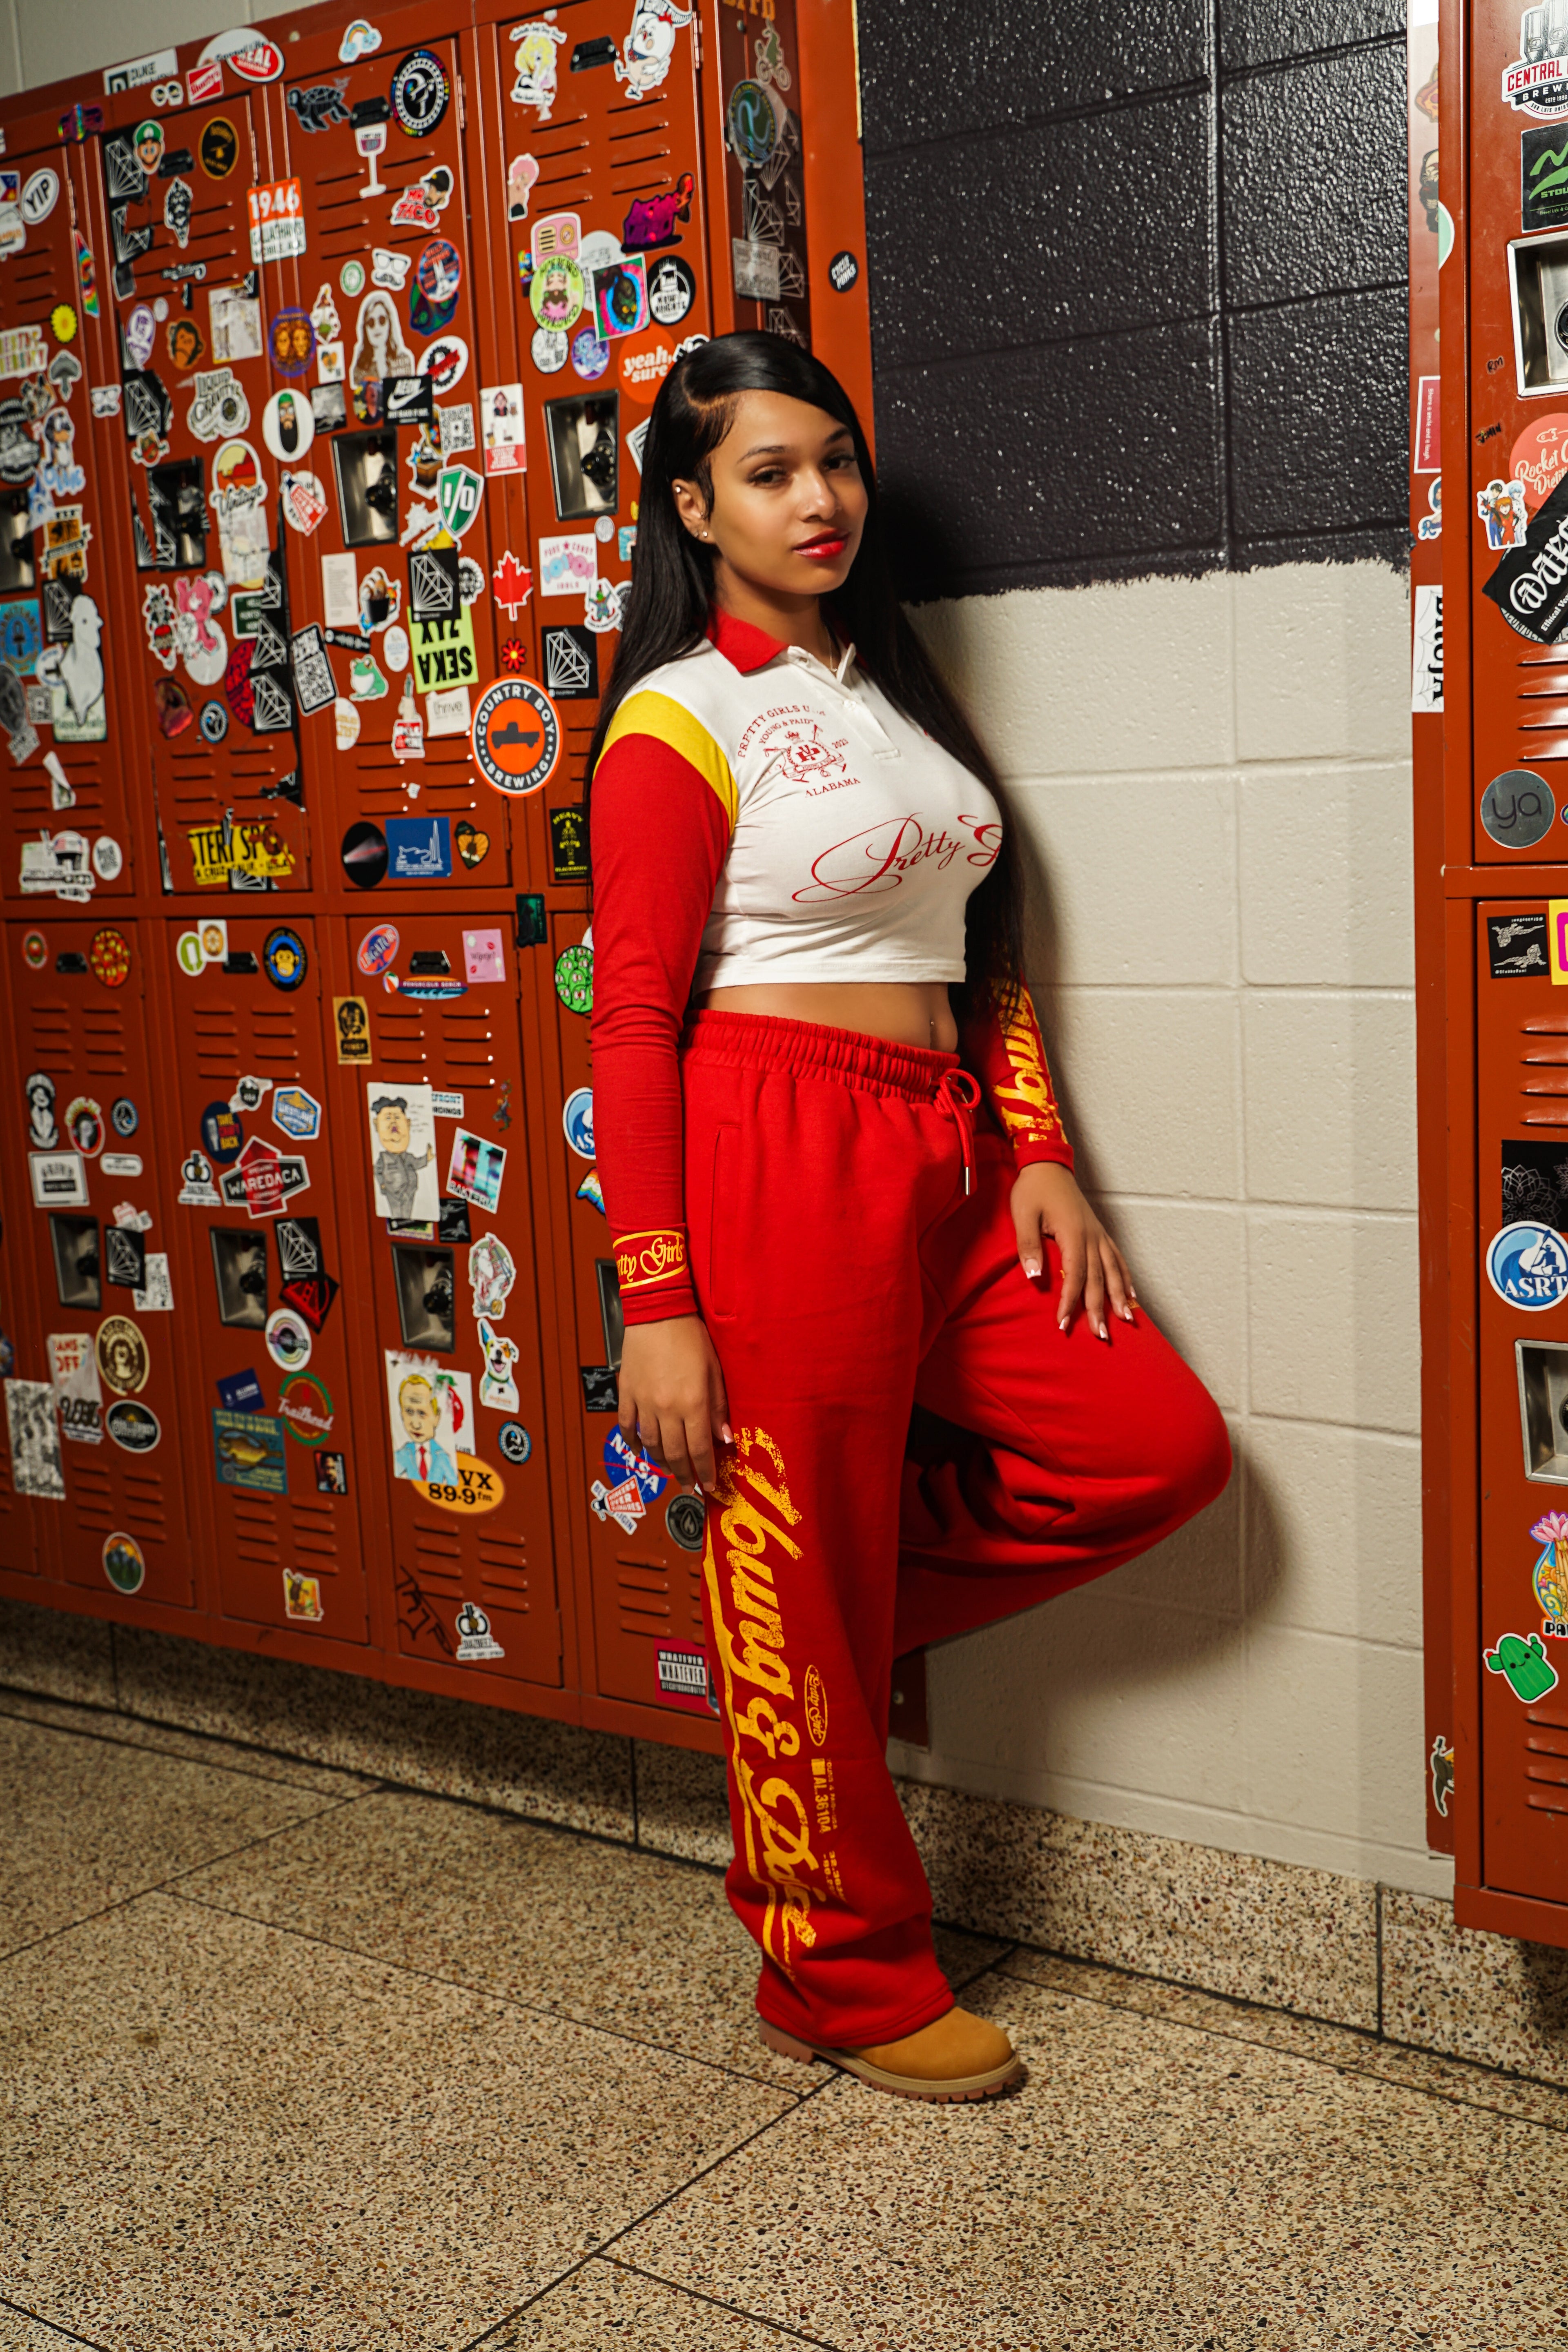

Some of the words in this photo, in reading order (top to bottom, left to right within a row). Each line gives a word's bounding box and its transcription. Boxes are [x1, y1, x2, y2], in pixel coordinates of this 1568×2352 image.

[1507, 61, 1562, 92] CENTRAL
[1522, 82, 1568, 102] BREW
[25, 178, 49, 213] YIP
[249, 185, 300, 220] 1946
[406, 187, 425, 203] MR
[396, 204, 437, 224] TACO
[622, 345, 673, 376] yeah,
[630, 365, 668, 383] sure
[1487, 356, 1503, 373] RM
[1515, 448, 1559, 483] Rocket
[1541, 604, 1561, 632] Ethical
[477, 683, 532, 736] COUNTRY
[533, 695, 555, 734] BOY
[738, 714, 766, 758] PRETTY
[767, 705, 800, 718] GIRLS
[759, 723, 782, 745] YOUNG
[486, 759, 549, 789] BREWING
[804, 777, 861, 798] ALABAMA
[1492, 792, 1542, 829] ya
[792, 812, 965, 903] Pretty
[227, 1167, 301, 1196] WAREDACA
[1503, 1276, 1568, 1298] ASRT
[278, 1396, 334, 1431] Trailhead
[610, 1432, 659, 1494] NASA
[428, 1483, 477, 1504] 89.9
[477, 1491, 493, 1502] fm
[609, 1493, 632, 1507] OVER
[736, 1695, 801, 1762] &
